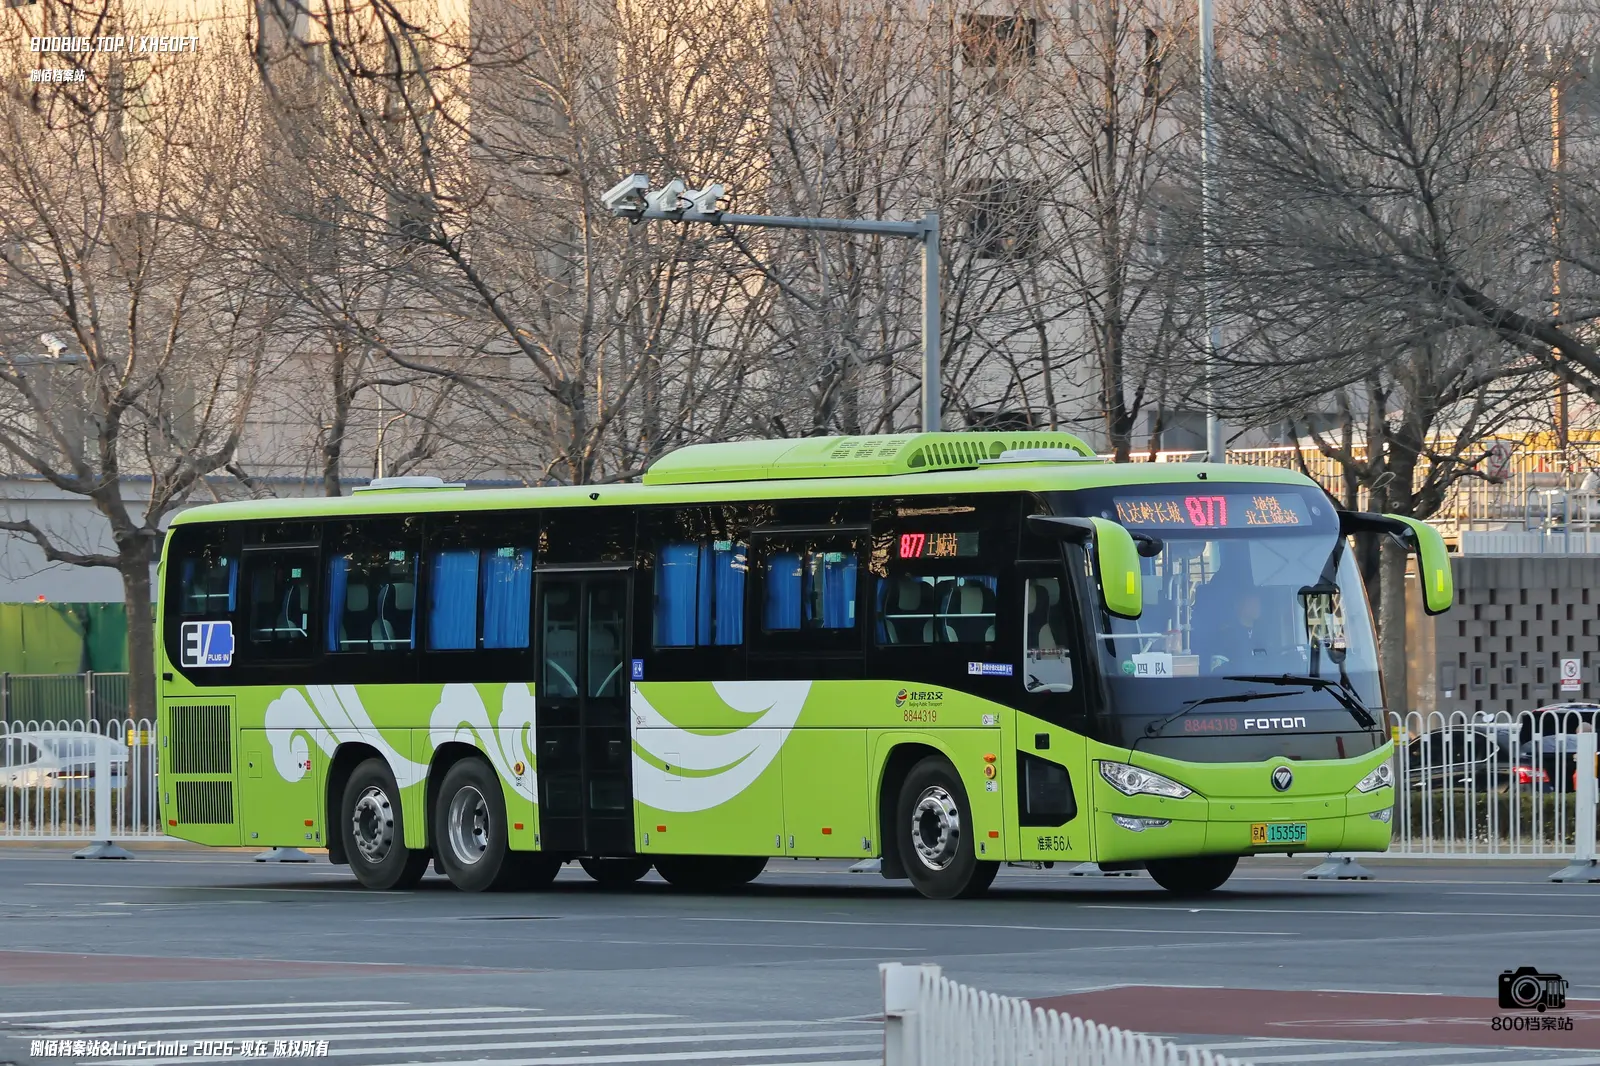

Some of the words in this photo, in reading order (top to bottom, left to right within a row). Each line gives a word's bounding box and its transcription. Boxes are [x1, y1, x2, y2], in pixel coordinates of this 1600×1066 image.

[1252, 496, 1281, 511] 地铁
[1116, 501, 1185, 524] 八达岭长城
[1184, 496, 1228, 527] 877
[1245, 510, 1299, 525] 北土城站
[900, 533, 925, 558] 877
[927, 532, 958, 557] 土城站
[909, 691, 944, 701] 北京公交
[903, 709, 937, 722] 8844319
[1184, 718, 1238, 732] 8844319
[1244, 717, 1306, 730] FOTON
[1271, 825, 1306, 840] 15355F
[1037, 835, 1073, 851] 准乘56人
